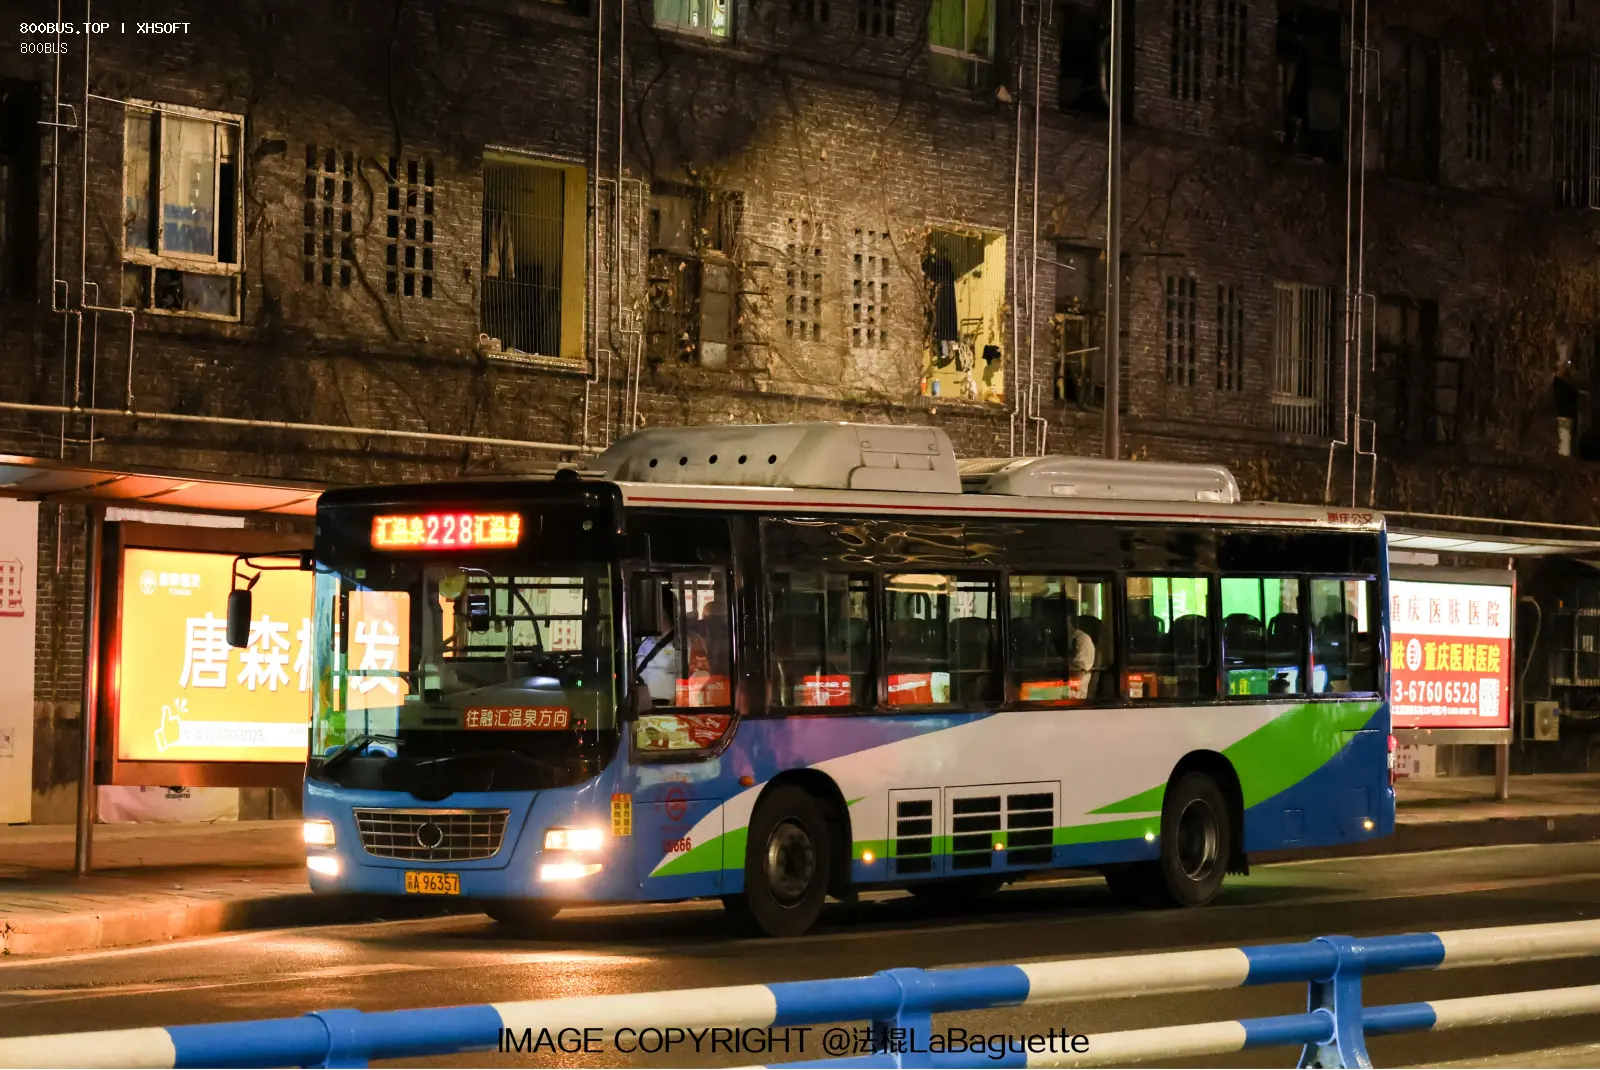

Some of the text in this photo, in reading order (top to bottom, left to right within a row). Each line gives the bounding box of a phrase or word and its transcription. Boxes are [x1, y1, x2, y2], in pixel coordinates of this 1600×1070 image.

[427, 513, 473, 545] 228
[465, 708, 569, 728] 往融汇温泉方向
